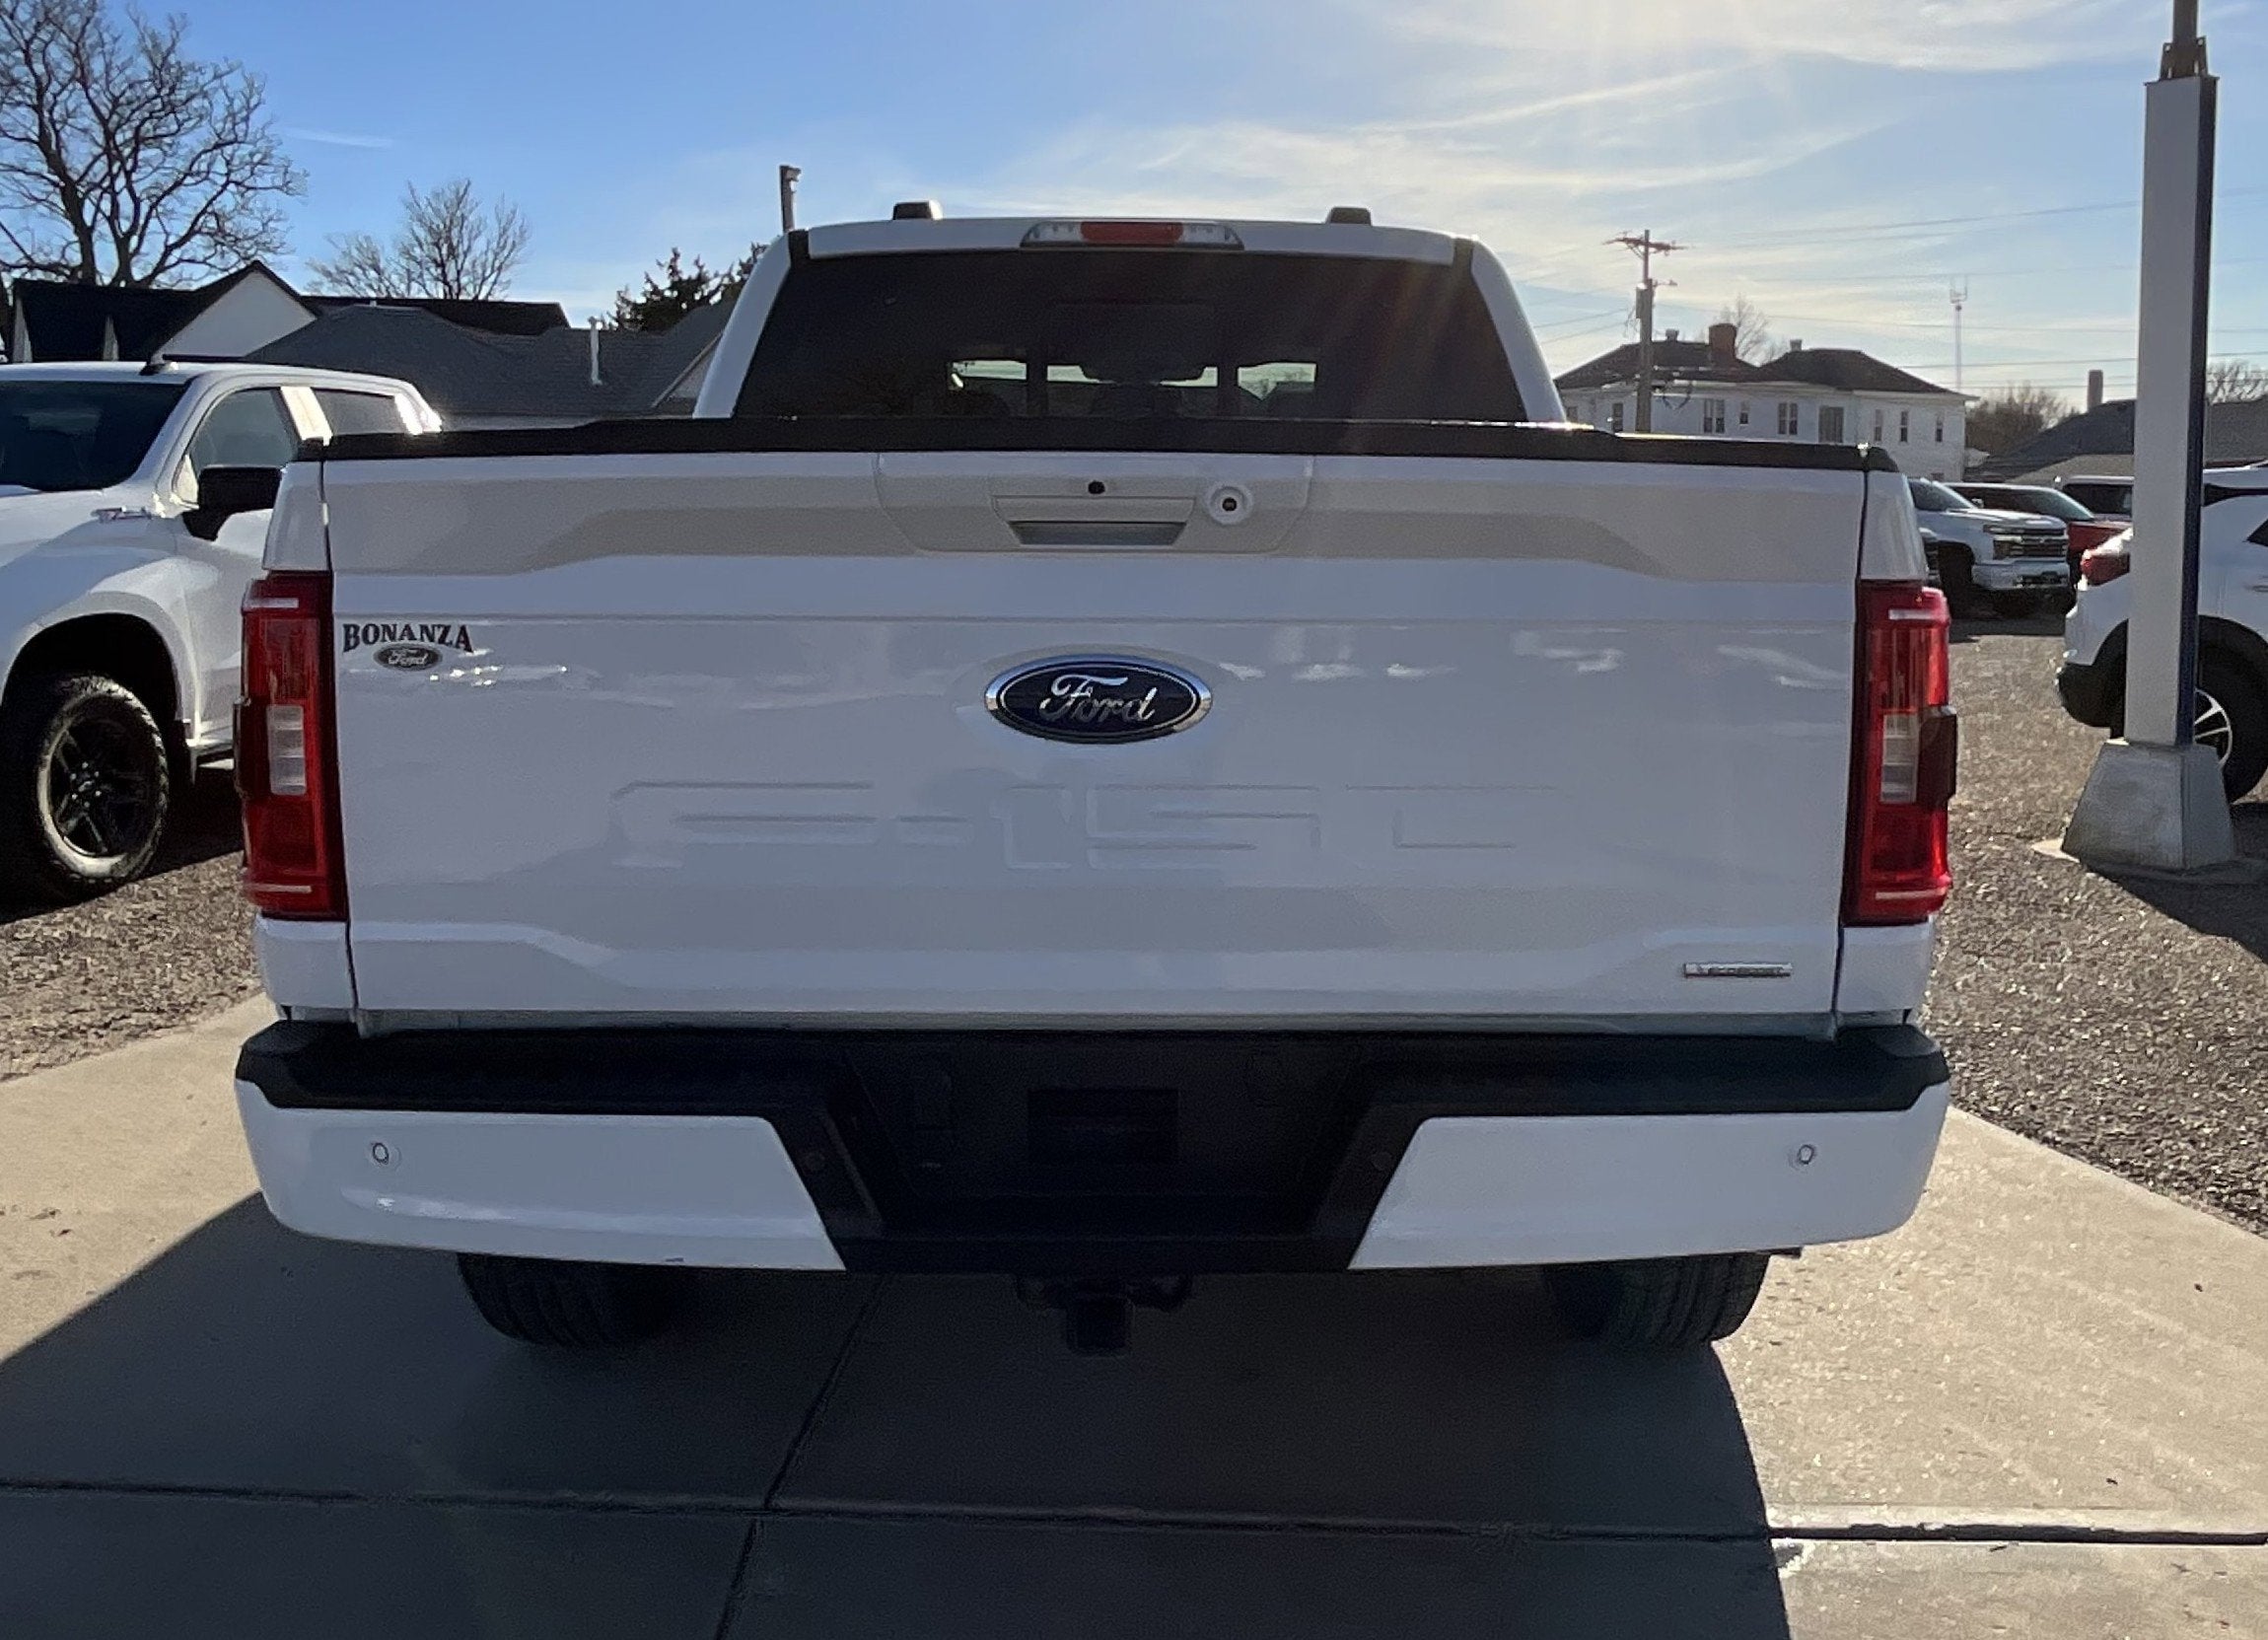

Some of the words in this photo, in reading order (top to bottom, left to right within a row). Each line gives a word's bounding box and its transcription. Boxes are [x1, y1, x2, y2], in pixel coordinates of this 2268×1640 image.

[342, 622, 473, 653] BONANZA
[388, 648, 428, 665] Ford
[1038, 673, 1159, 723] Ford
